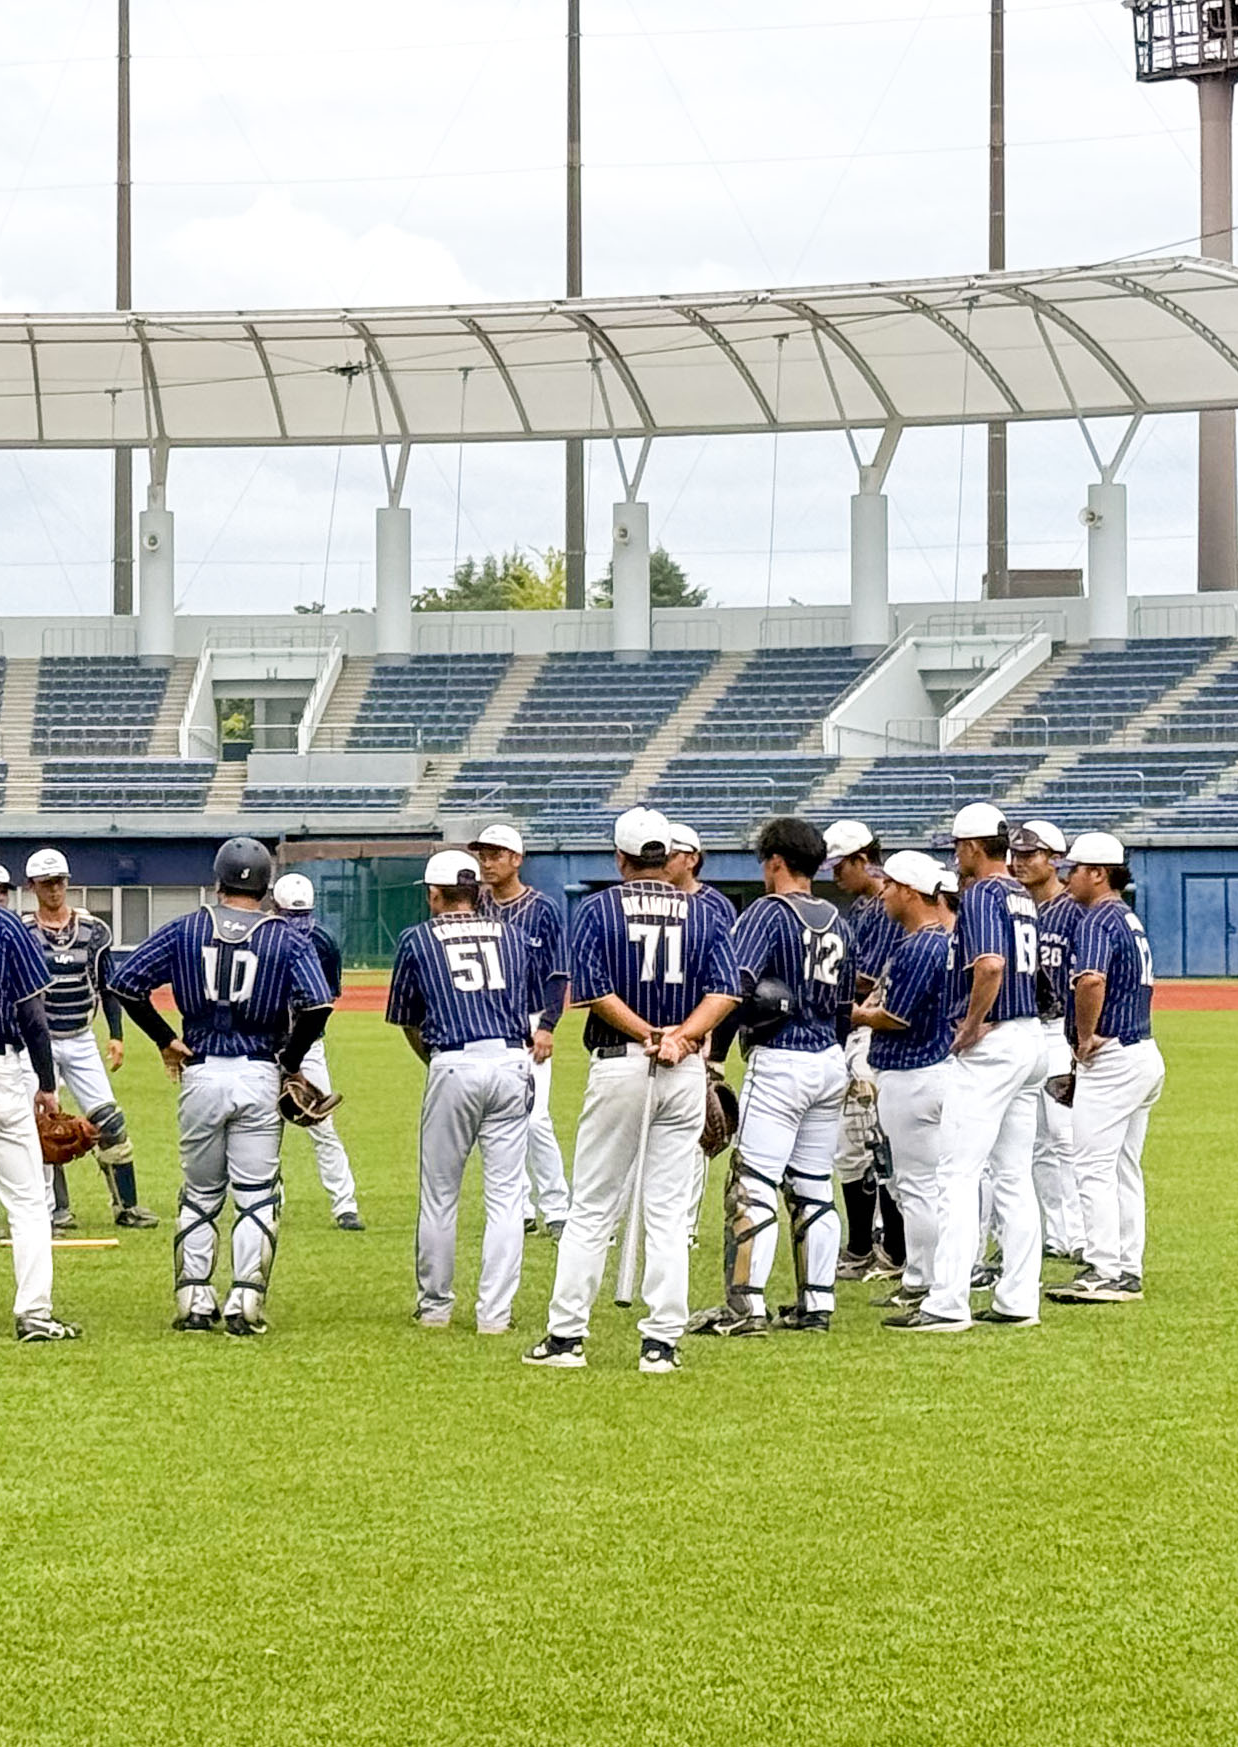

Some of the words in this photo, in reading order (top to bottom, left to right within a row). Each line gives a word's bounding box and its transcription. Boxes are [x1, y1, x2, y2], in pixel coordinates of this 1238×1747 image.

[622, 895, 689, 919] OKAMOTO
[202, 946, 259, 1003] 10
[445, 941, 506, 992] 51
[628, 923, 684, 984] 71
